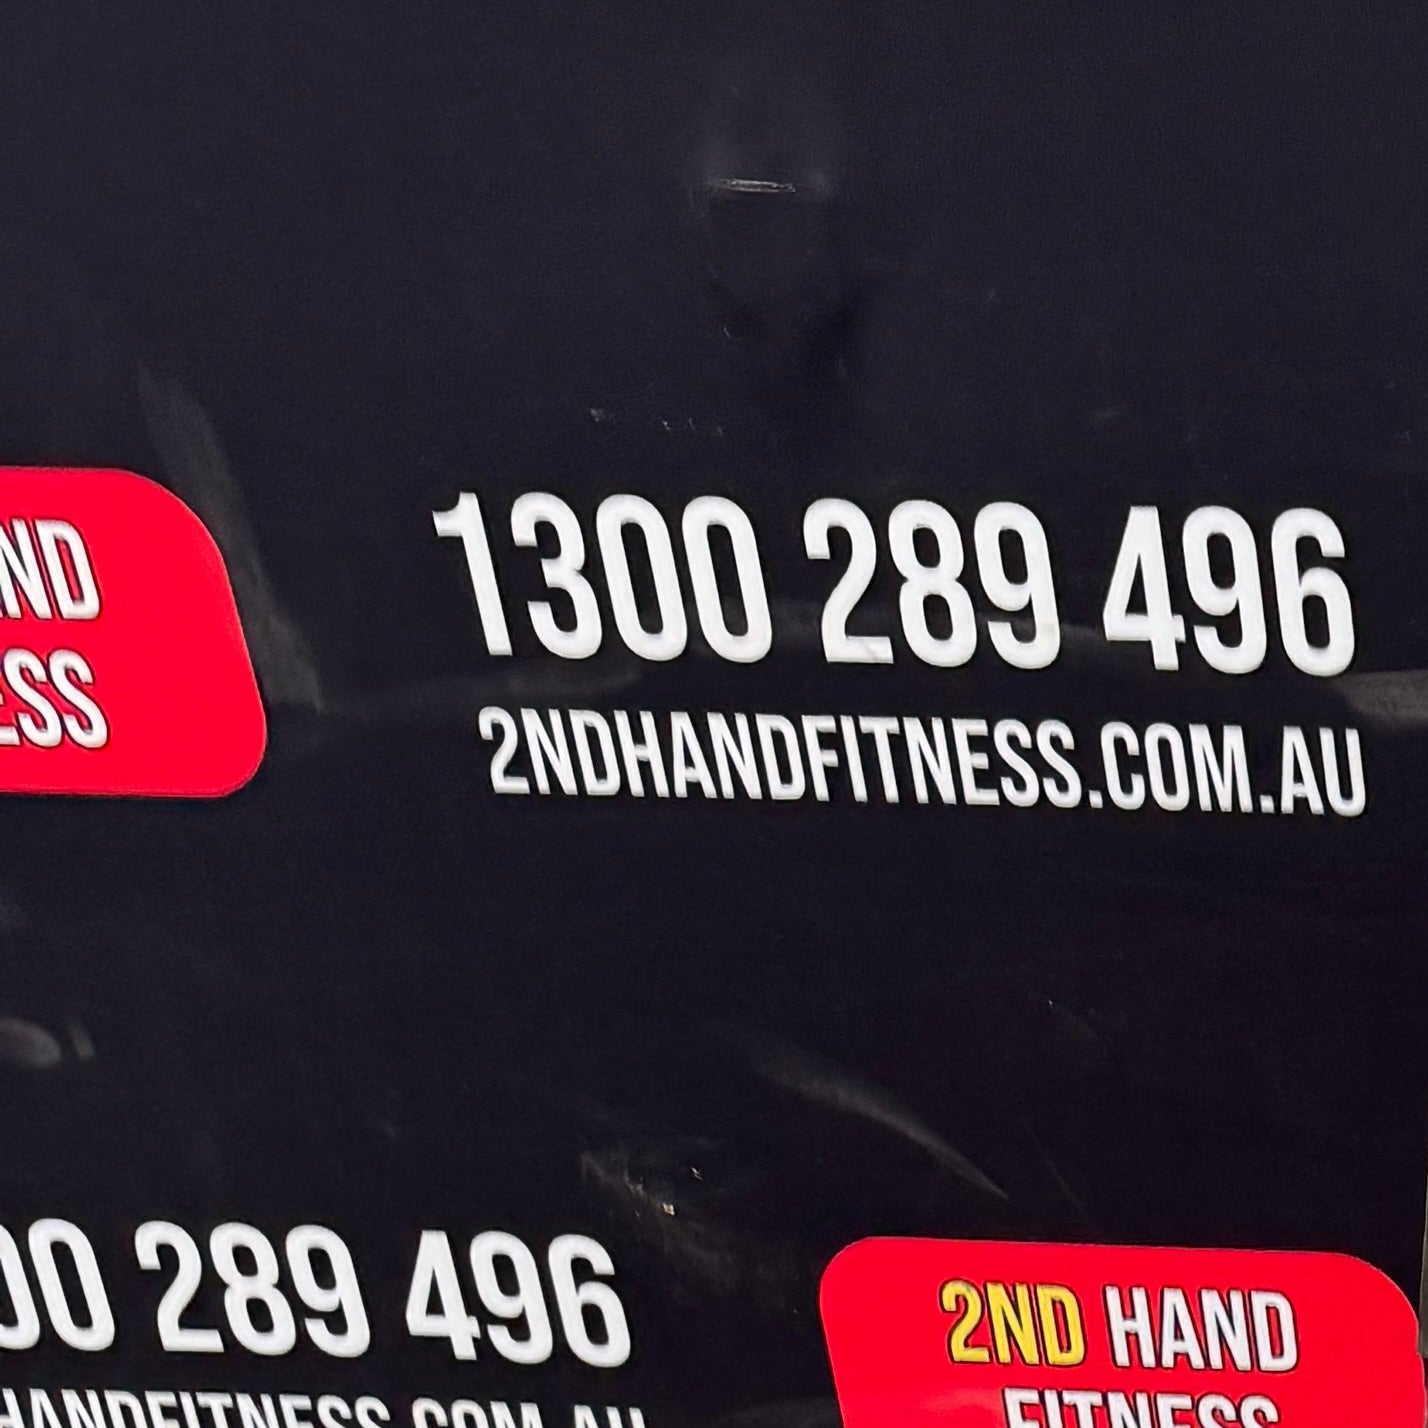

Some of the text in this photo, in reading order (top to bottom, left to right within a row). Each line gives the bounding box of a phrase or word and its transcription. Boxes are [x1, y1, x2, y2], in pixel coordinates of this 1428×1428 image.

[0, 518, 101, 620] ND
[432, 491, 1355, 677] 1300 289 496
[478, 706, 1366, 817] 2NDHANDFITNESS.COM.AU
[134, 1220, 371, 1358] 289
[405, 1230, 631, 1368] 496
[941, 1280, 1298, 1371] 2ND HAND
